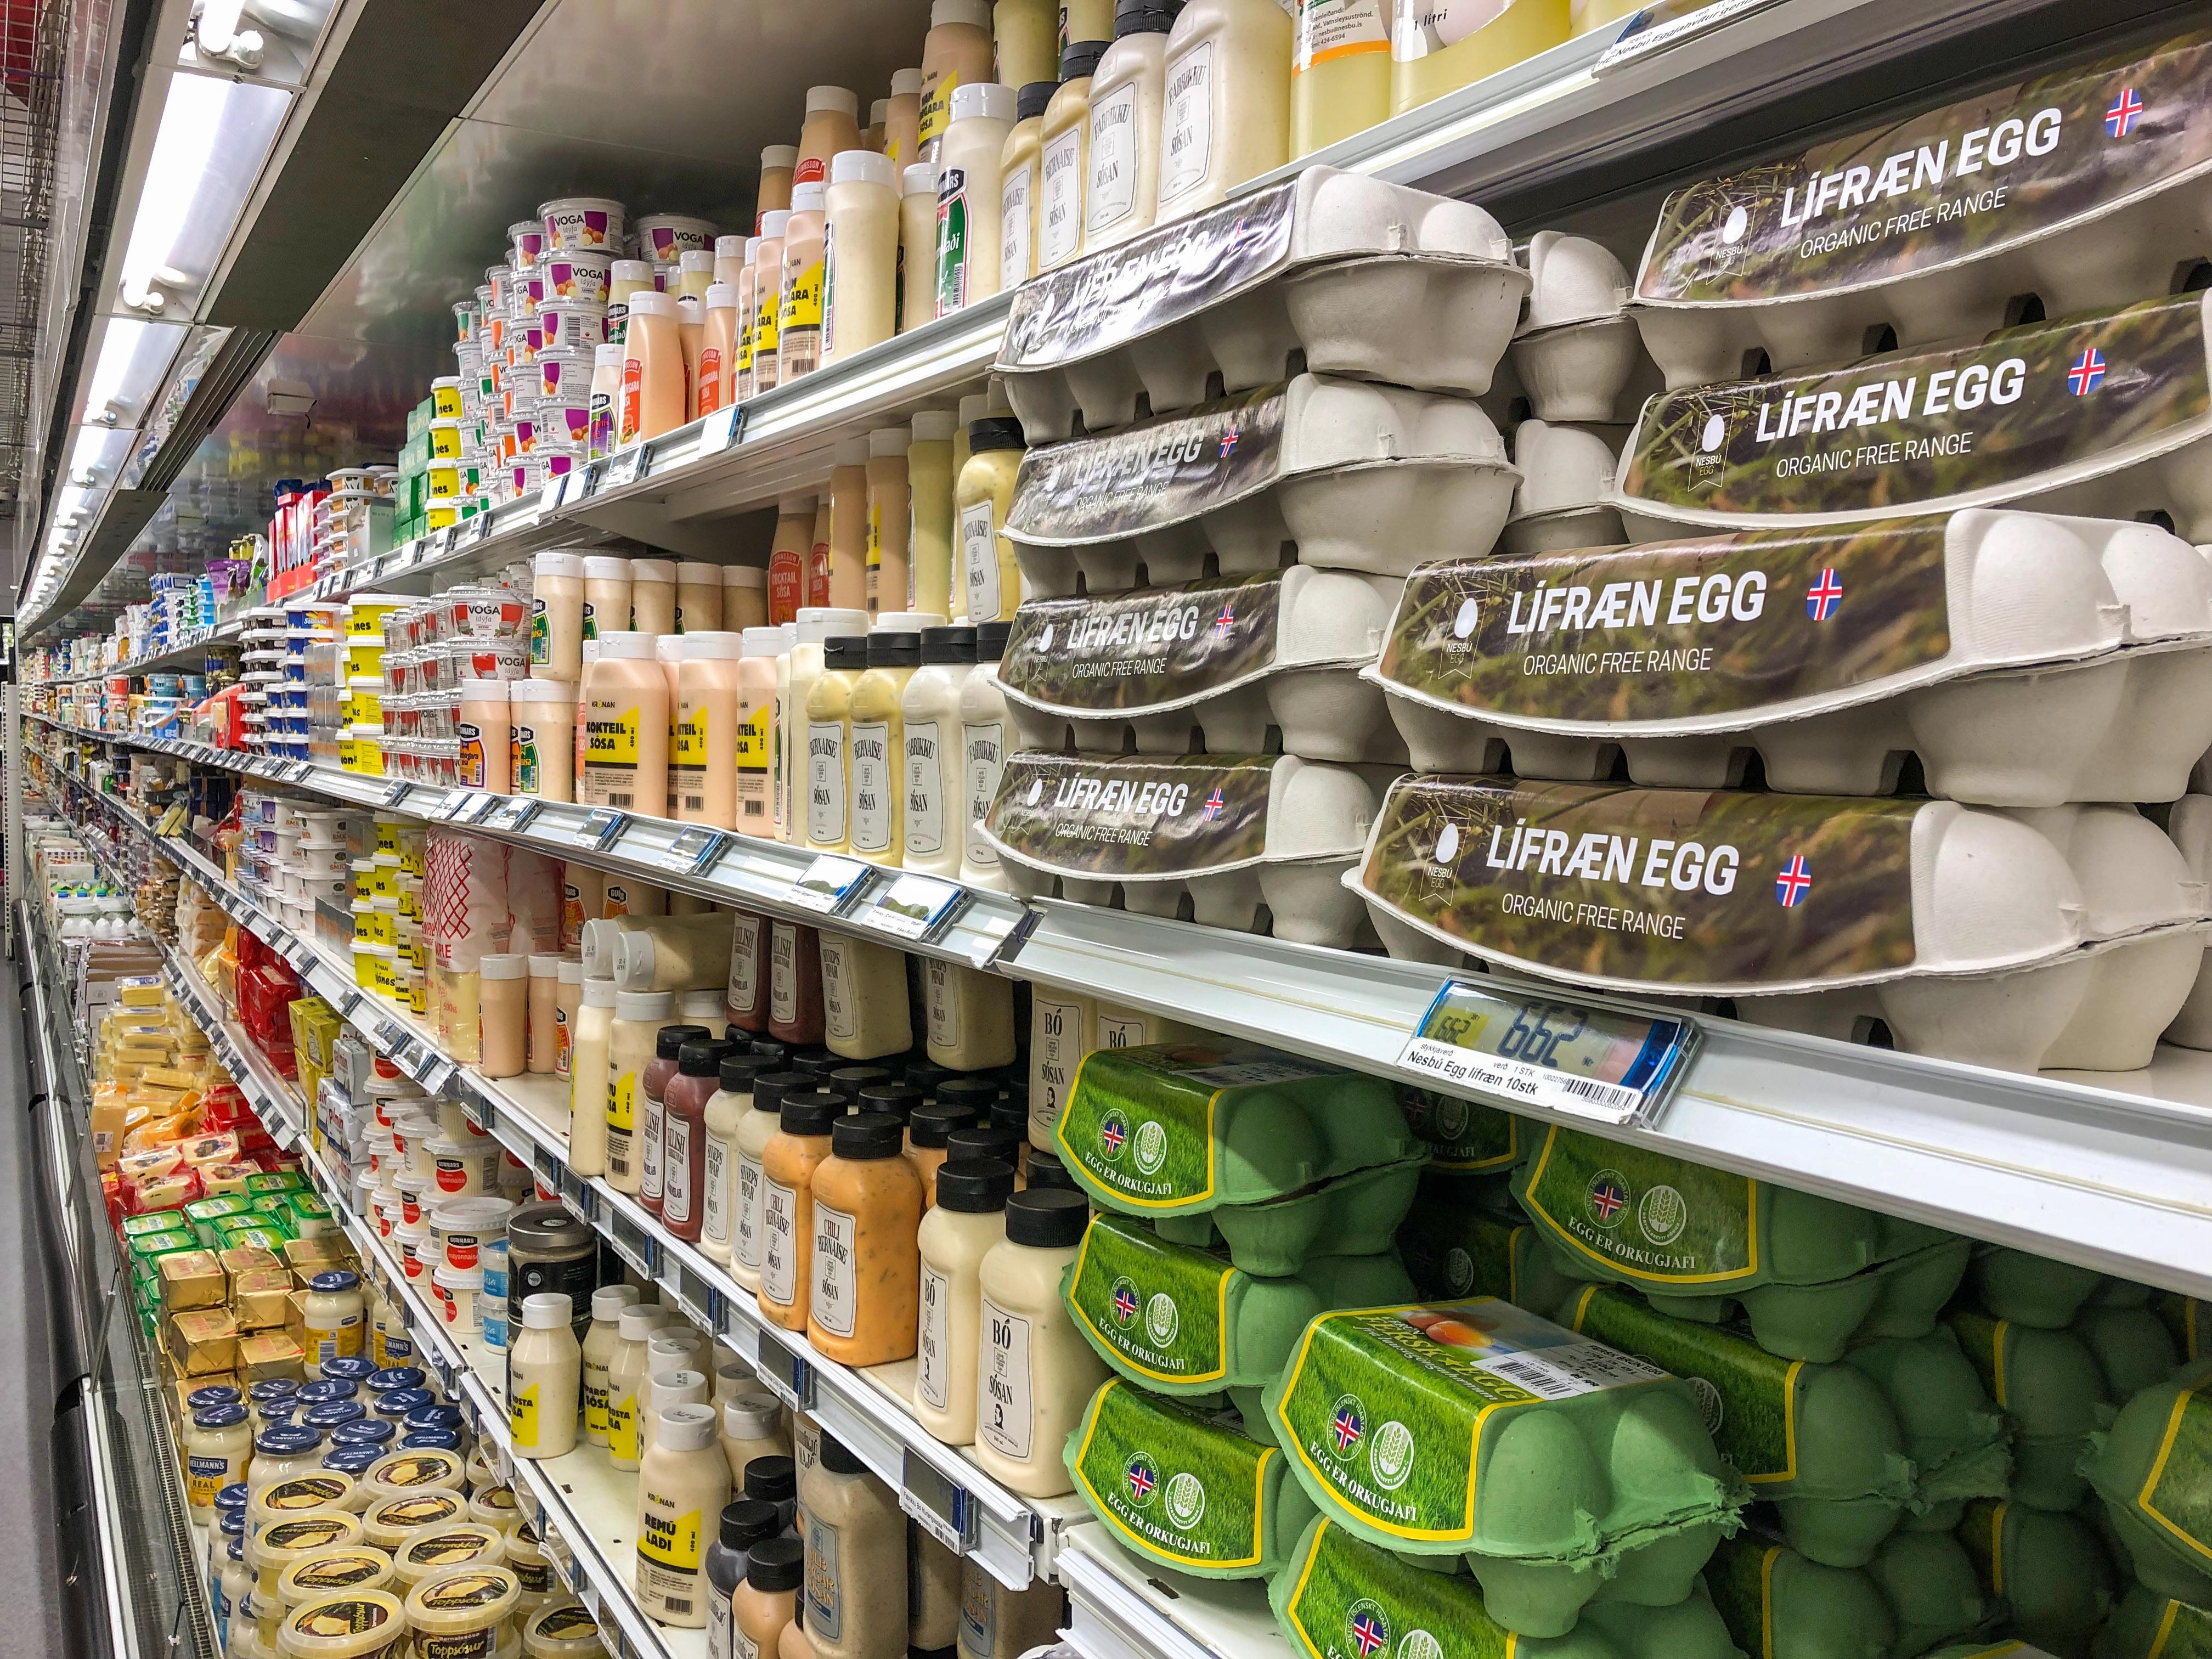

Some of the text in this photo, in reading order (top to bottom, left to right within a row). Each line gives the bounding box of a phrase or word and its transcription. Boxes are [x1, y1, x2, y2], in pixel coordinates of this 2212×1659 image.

[1168, 65, 1207, 107] FABRIKKU
[1094, 104, 1131, 142] FABRIKKU
[1170, 125, 1193, 157] SÓSAN
[1045, 148, 1075, 183] BERNAISE
[1097, 160, 1119, 189] SÓSAN
[1779, 106, 2063, 228] LÍFRÆN EGG
[554, 215, 585, 227] VOGA
[1048, 202, 1066, 228] SÓSAN
[1799, 186, 2009, 260] ORGANIC FREE RANGE
[674, 232, 703, 244] VOGA
[1715, 242, 1744, 261] NESBÚ
[572, 268, 603, 280] VOGA
[1755, 358, 2027, 442] LÍFRÆN EGG
[1072, 429, 1207, 488] LÍFRÆN EGG
[1695, 453, 1722, 469] NESBÚ
[1775, 431, 1974, 478] ORGANIC FREE RANGE
[1699, 465, 1714, 476] EGG
[1074, 481, 1167, 511] ORGANIC FREE RANGE
[771, 571, 797, 585] COCKTAIL
[969, 566, 985, 589] SÓSAN
[776, 584, 791, 599] SÓSA
[1506, 570, 1768, 634] LÍFRÆN EGG
[467, 605, 501, 615] VOGA
[1066, 605, 1200, 651] LÍFRÆN EGG
[1446, 640, 1473, 654] NESBÚ
[497, 657, 525, 668] VOGA
[1072, 657, 1167, 679] ORGANIC FREE RANGE
[1523, 647, 1713, 676] ORGANIC FREE RANGE
[591, 700, 616, 709] KRÓNAN
[586, 721, 627, 735] KOKTEIL
[590, 733, 616, 750] SÓSA
[810, 737, 838, 758] BERNAISE
[854, 738, 883, 761] BERNAISE
[906, 737, 935, 760] FABRIKKU
[968, 740, 999, 764] FABRIKKU
[814, 785, 831, 805] SÓSAN
[858, 789, 876, 811] SÓSAN
[910, 788, 928, 812] SÓSAN
[1053, 771, 1189, 817] LÍFRÆN EGG
[973, 795, 990, 819] SÓSAN
[1055, 823, 1153, 848] ORGANIC FREE RANGE
[1486, 817, 1739, 895] LÍFRÆN EGG
[1427, 865, 1453, 878] NESBÚ
[1430, 878, 1446, 889] EGG
[1502, 893, 1686, 940] ORGANIC FREE RANGE
[829, 996, 842, 1014] SÓSAN
[933, 1005, 946, 1022] SÓSAN
[1045, 1008, 1063, 1037] BÓ
[1109, 1025, 1127, 1048] BÓ
[1496, 1001, 1589, 1068] 662
[1420, 1043, 1453, 1057] stykkjaverð
[1041, 1060, 1065, 1085] SÓSAN
[1407, 1050, 1539, 1096] Nesbú Egg lífræn 10stk
[1493, 1060, 1509, 1070] verð
[1519, 1066, 1536, 1077] STK
[438, 1160, 460, 1169] GUNNARS
[1085, 1151, 1172, 1195] EGG ER ORKUGJAFI
[740, 1165, 759, 1189] SINNEPS
[742, 1181, 754, 1201] PIPAR
[770, 1194, 783, 1214] CHILI
[740, 1218, 753, 1239] SÓSAN
[766, 1209, 790, 1237] BERNAISE
[824, 1219, 840, 1241] CHILI
[449, 1236, 475, 1244] GUNNARS
[817, 1235, 848, 1265] BERNAISE
[1568, 1215, 1695, 1268] EGG ER ORKUGJAFI
[768, 1250, 781, 1271] SÓSAN
[822, 1277, 839, 1301] SÓSAN
[924, 1277, 935, 1307] BÓ
[922, 1328, 936, 1359] SÓSAN
[992, 1318, 1012, 1350] BÓ
[1098, 1317, 1185, 1370] EGG ER ORKUGJAFI
[989, 1374, 1013, 1406] SÓSAN
[1451, 1367, 1533, 1400] EGG
[192, 1477, 215, 1489] REAL
[1310, 1440, 1417, 1521] EGG ER ORKUGJAFI
[647, 1492, 675, 1509] KRÓNAN
[645, 1513, 676, 1536] REMÚ
[1108, 1491, 1211, 1554] EGG ER ORKUGJAFI
[646, 1530, 672, 1552] LAÐI
[691, 1531, 696, 1539] ml
[430, 1640, 484, 1658] Toppsósur
